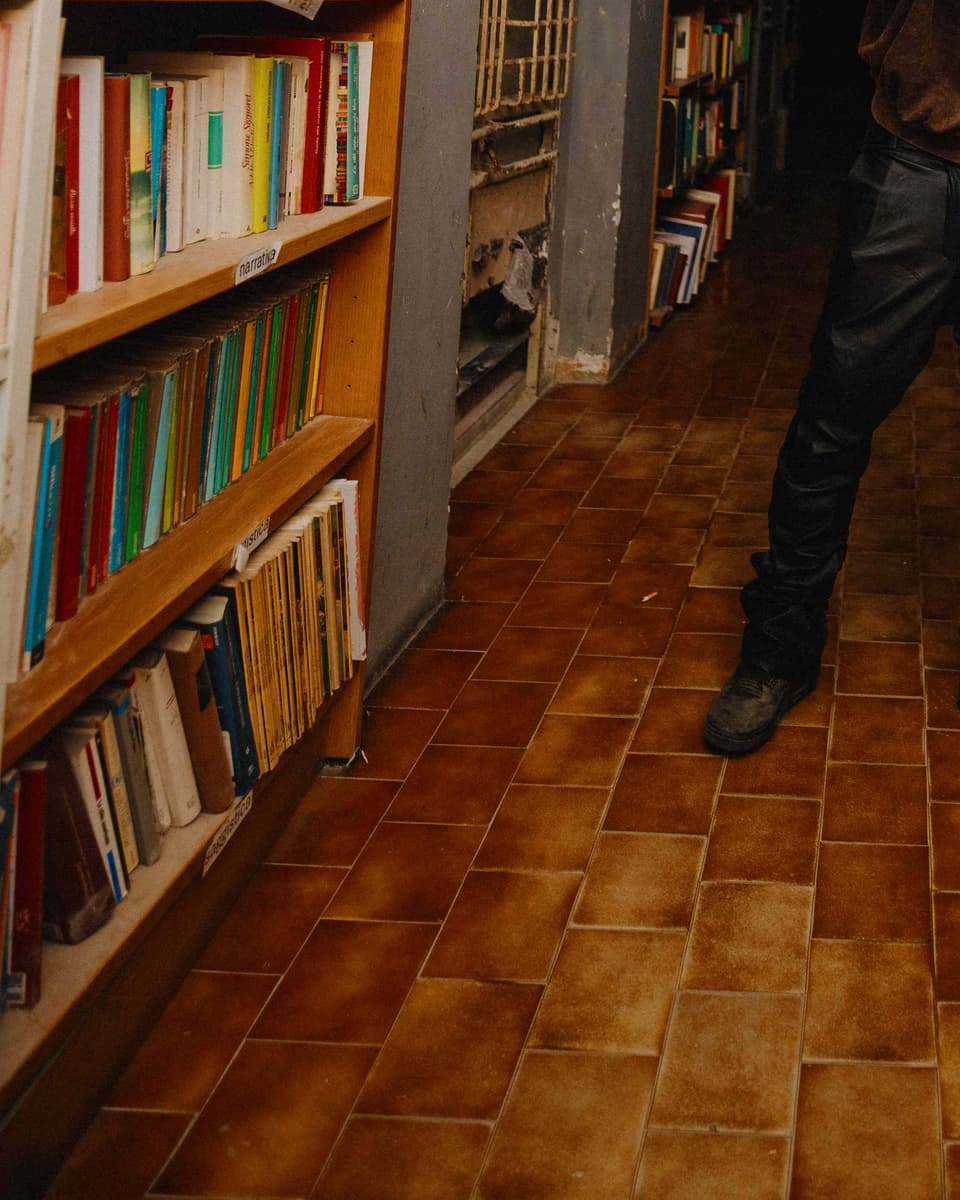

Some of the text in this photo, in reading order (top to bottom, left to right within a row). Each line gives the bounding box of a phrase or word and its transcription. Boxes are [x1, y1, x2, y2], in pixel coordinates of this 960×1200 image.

[243, 93, 253, 131] Signoret
[241, 132, 250, 170] Simone
[239, 248, 276, 277] narrativa
[203, 795, 254, 868] saggistica
